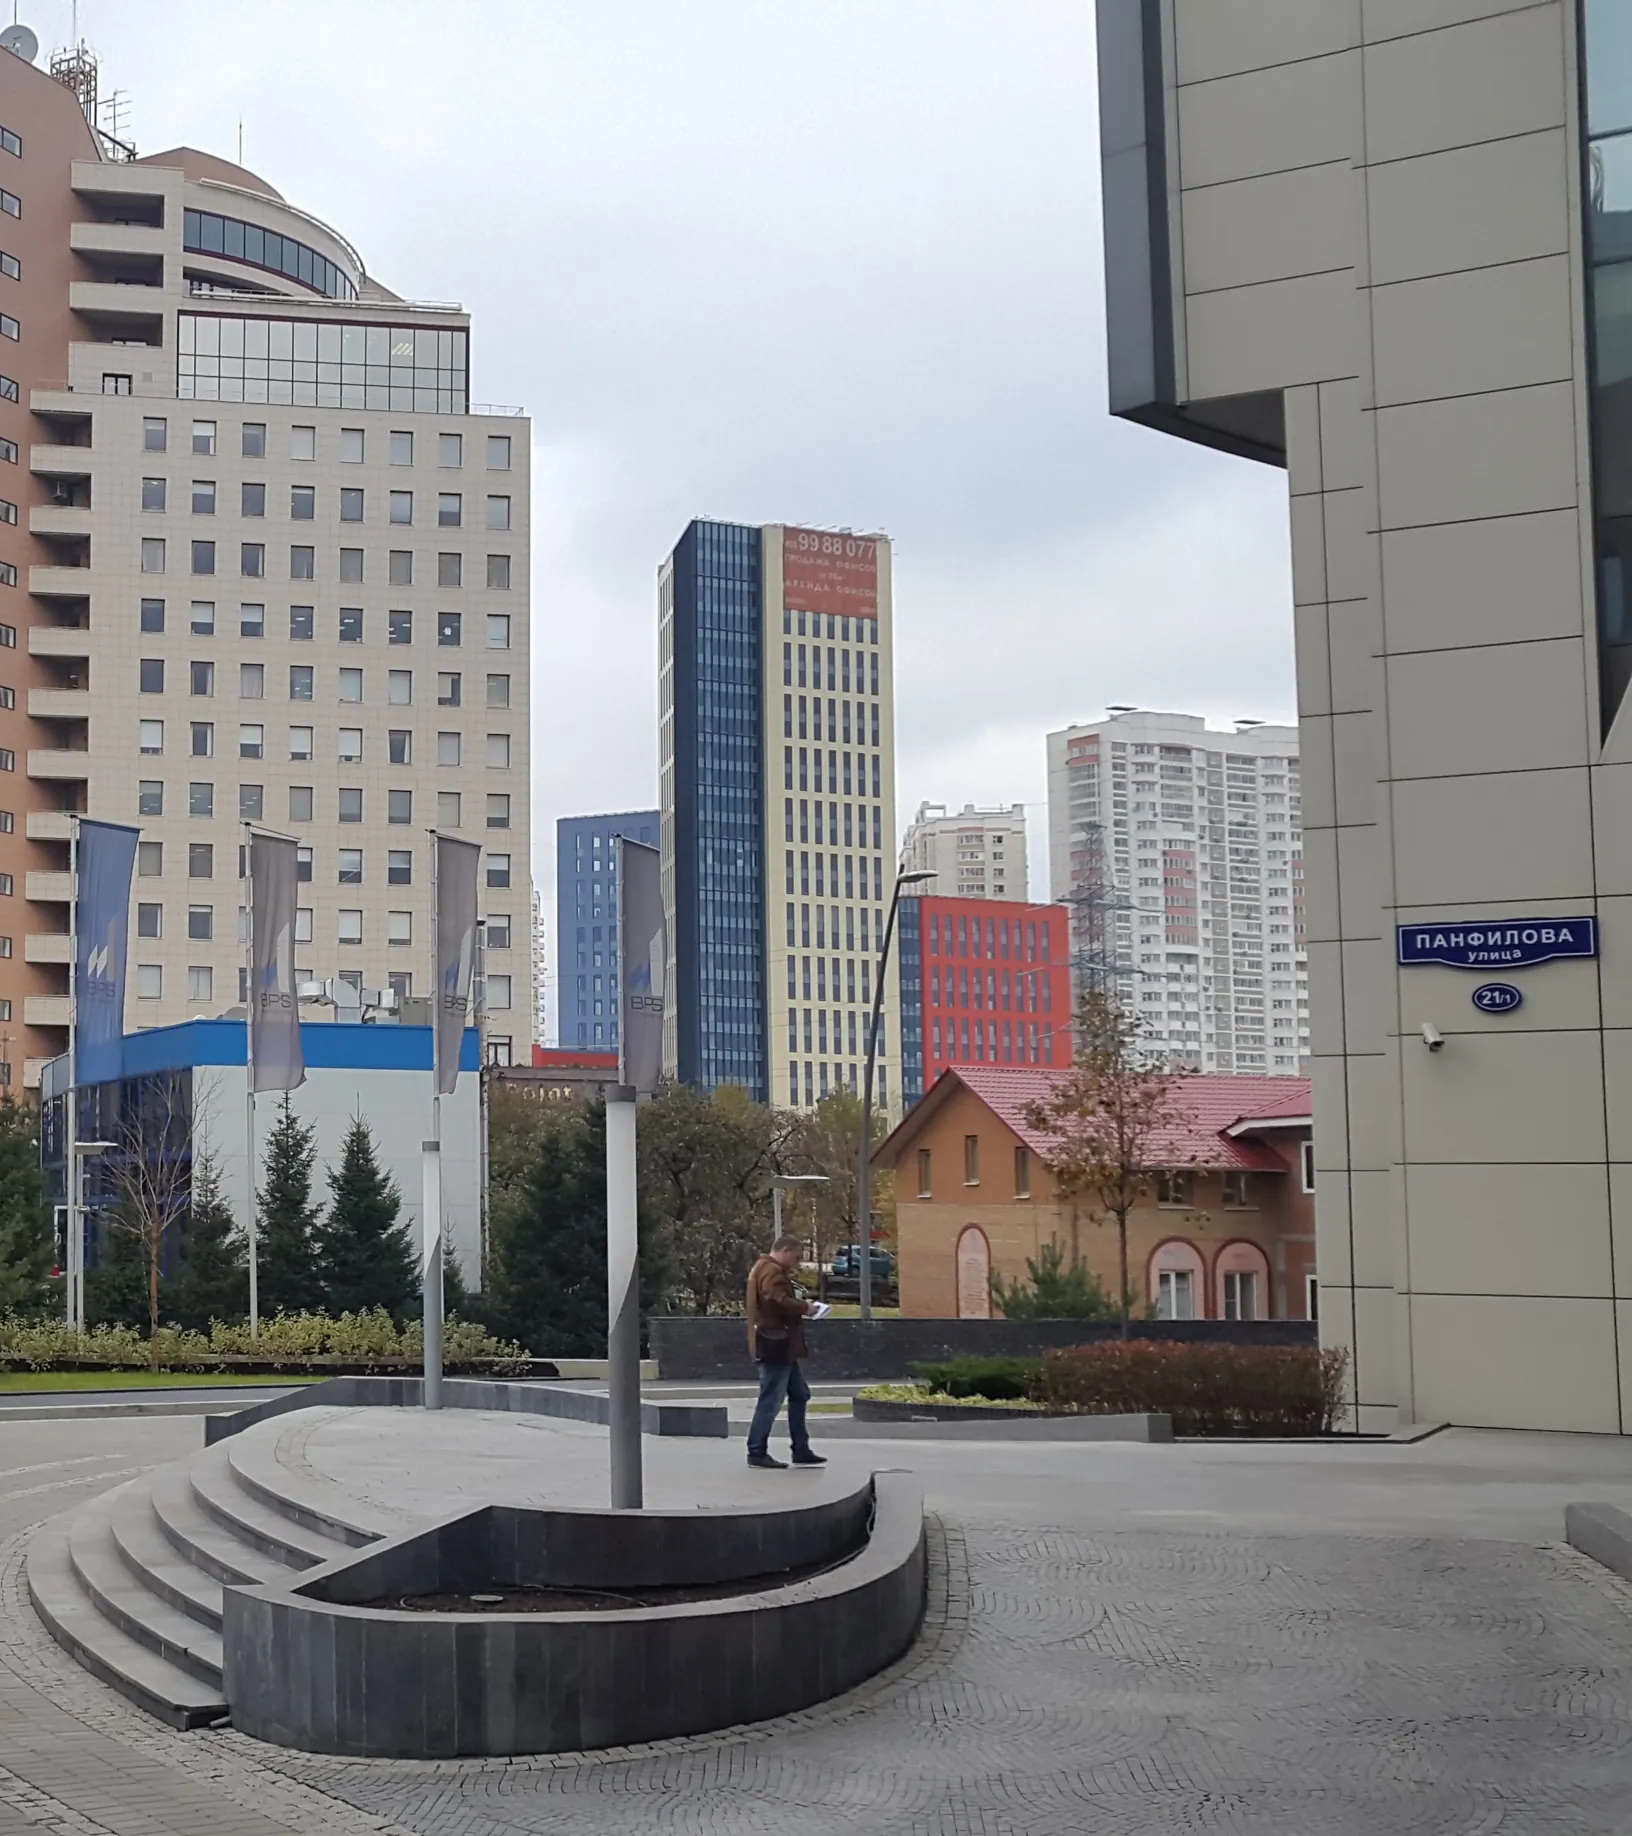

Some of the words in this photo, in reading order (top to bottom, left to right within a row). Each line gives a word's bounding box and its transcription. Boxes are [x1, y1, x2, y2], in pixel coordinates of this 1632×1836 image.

[799, 533, 819, 551] 99
[822, 536, 843, 555] 88
[846, 540, 874, 560] 077
[1417, 928, 1574, 949] ПАНФИЛОВА
[1468, 949, 1522, 963] улица
[87, 980, 116, 997] BPS
[630, 996, 663, 1012] BPS
[1481, 990, 1511, 1004] 21/1
